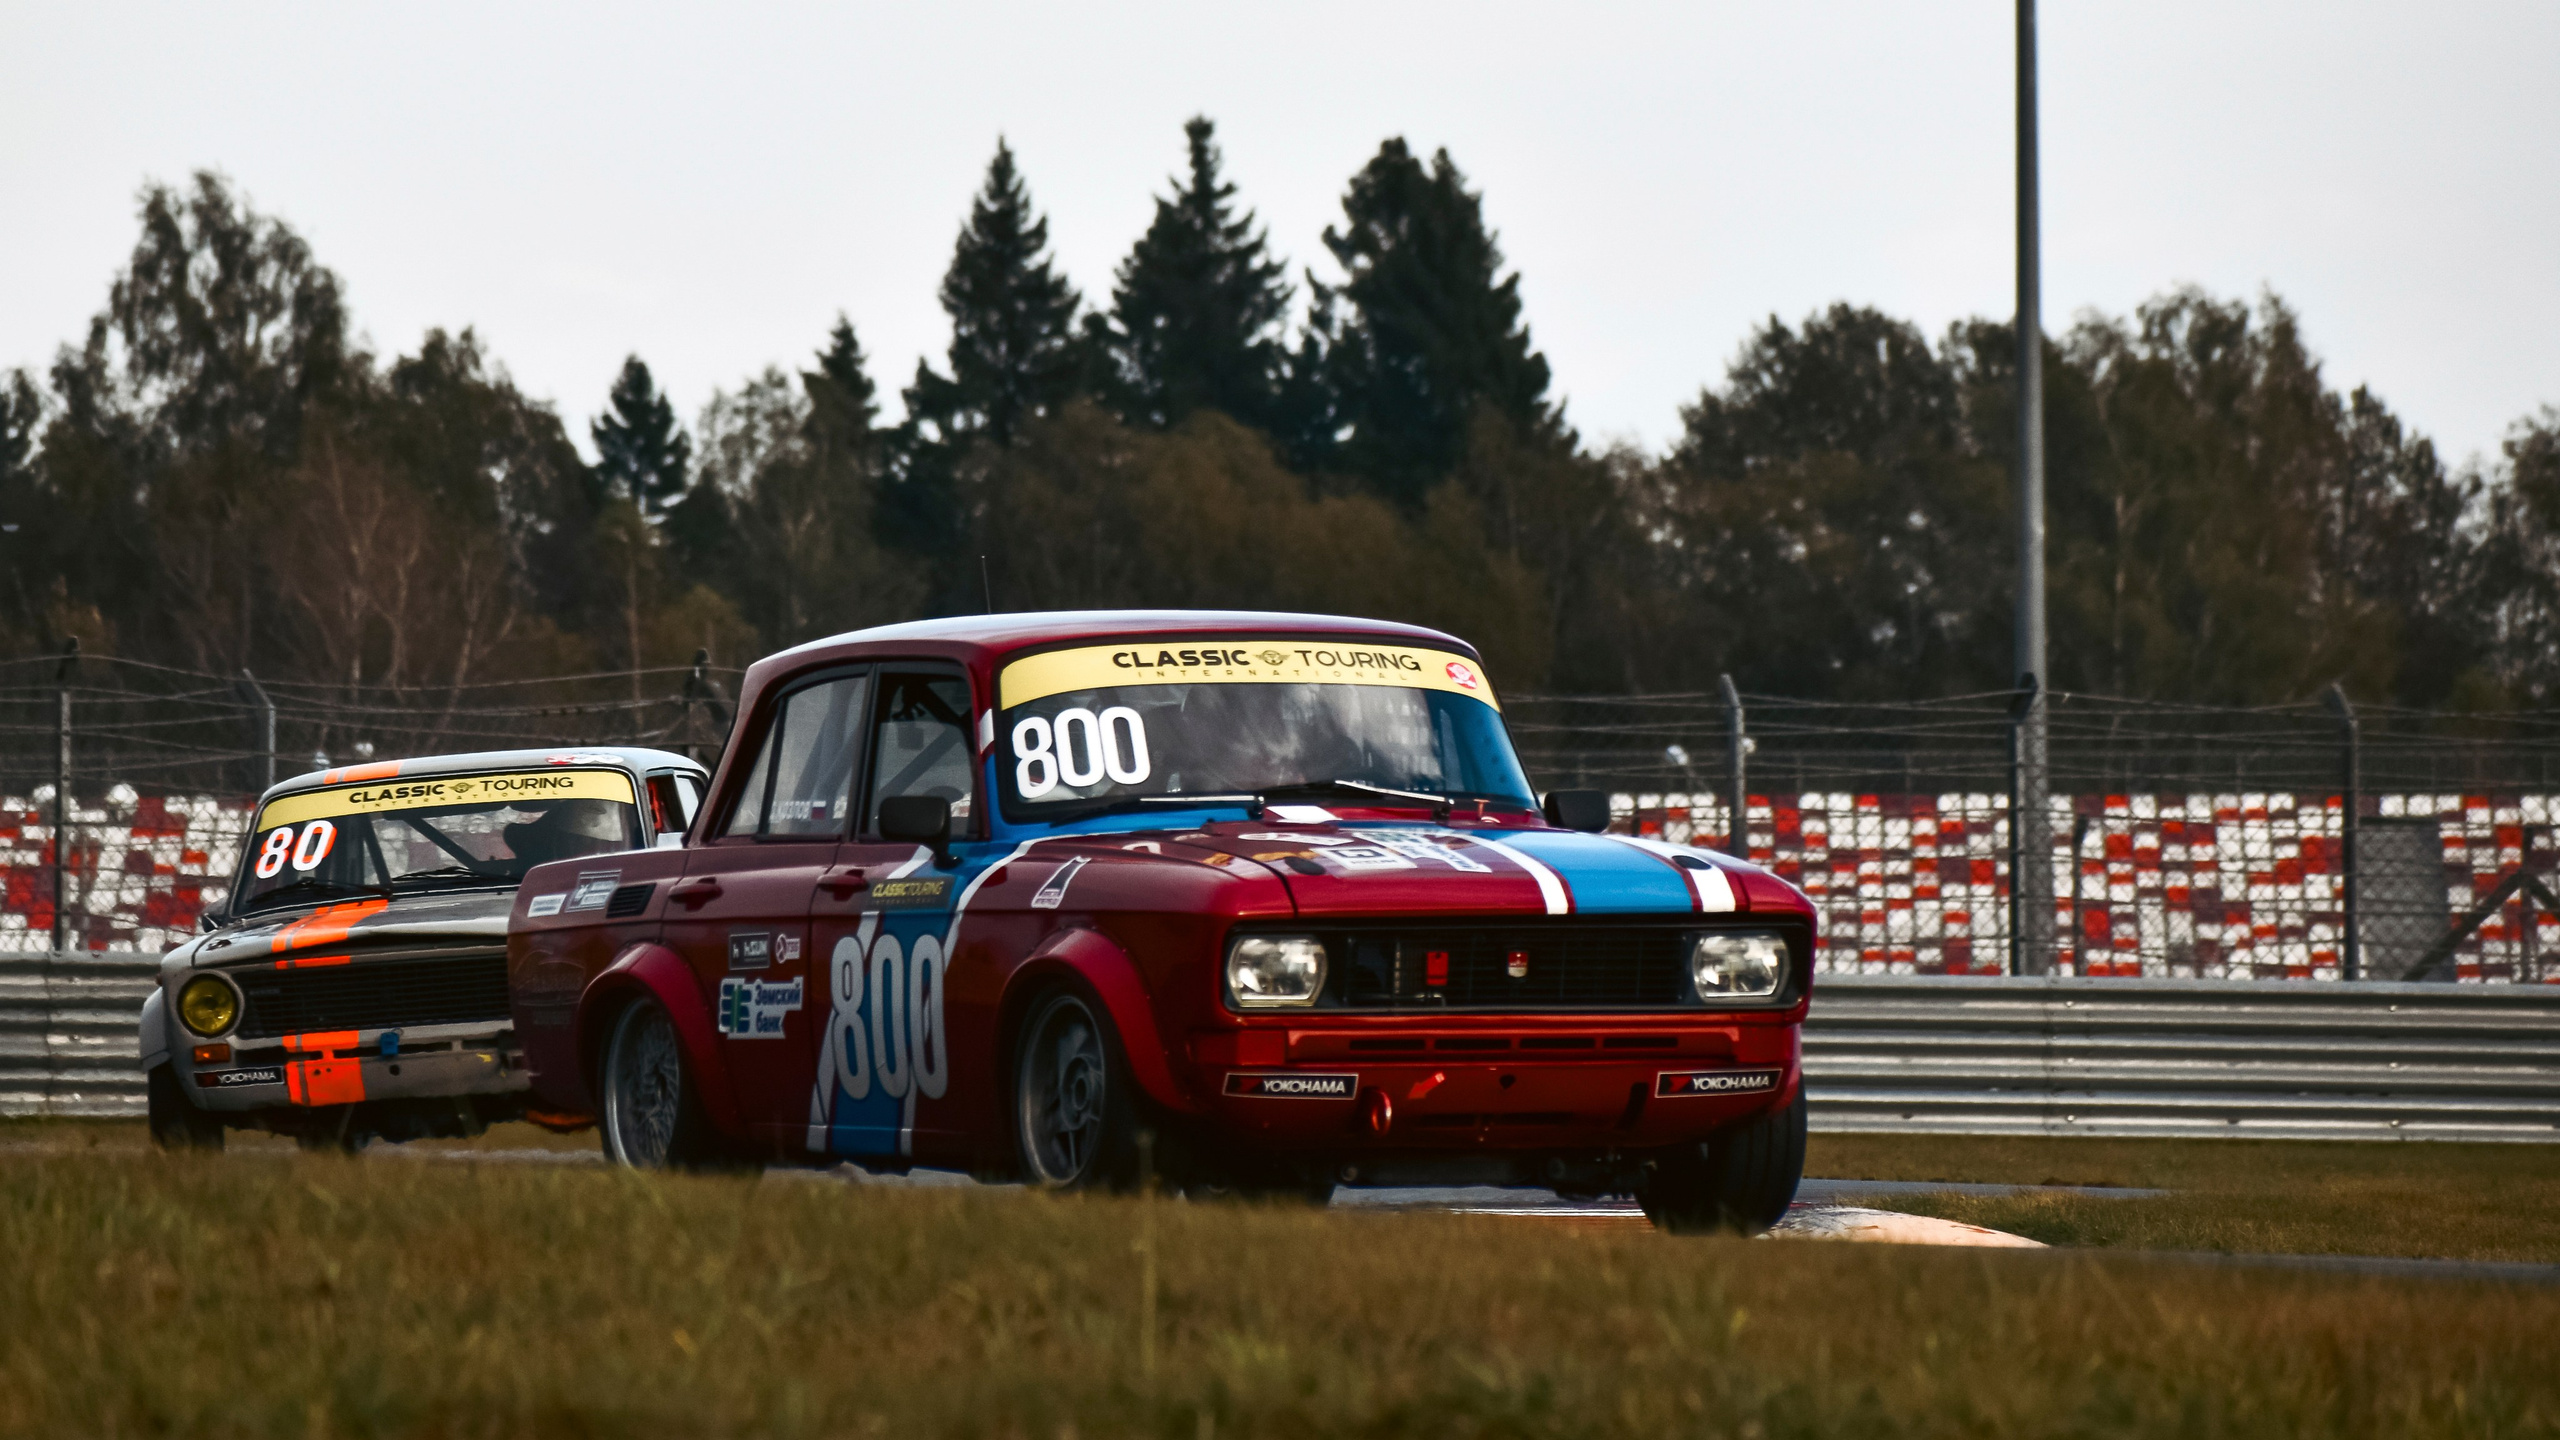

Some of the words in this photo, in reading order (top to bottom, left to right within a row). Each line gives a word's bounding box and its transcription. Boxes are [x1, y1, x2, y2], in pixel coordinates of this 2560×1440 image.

[1111, 649, 1251, 668] CLASSIC
[1294, 649, 1422, 672] TOURING
[1137, 668, 1409, 681] INTERNATIONAL
[1012, 706, 1151, 799] 800
[349, 783, 446, 804] CLASSIC
[479, 776, 575, 792] TOURING
[361, 790, 560, 809] INTERNATIONAL
[256, 819, 337, 880] 80
[755, 983, 801, 1006] Земский
[756, 1011, 783, 1033] банк
[830, 934, 948, 1100] 800
[218, 1071, 277, 1083] YOKOHAMA
[1263, 1080, 1346, 1094] YOKOHAMA
[1692, 1076, 1770, 1090] YOKOHAMA
